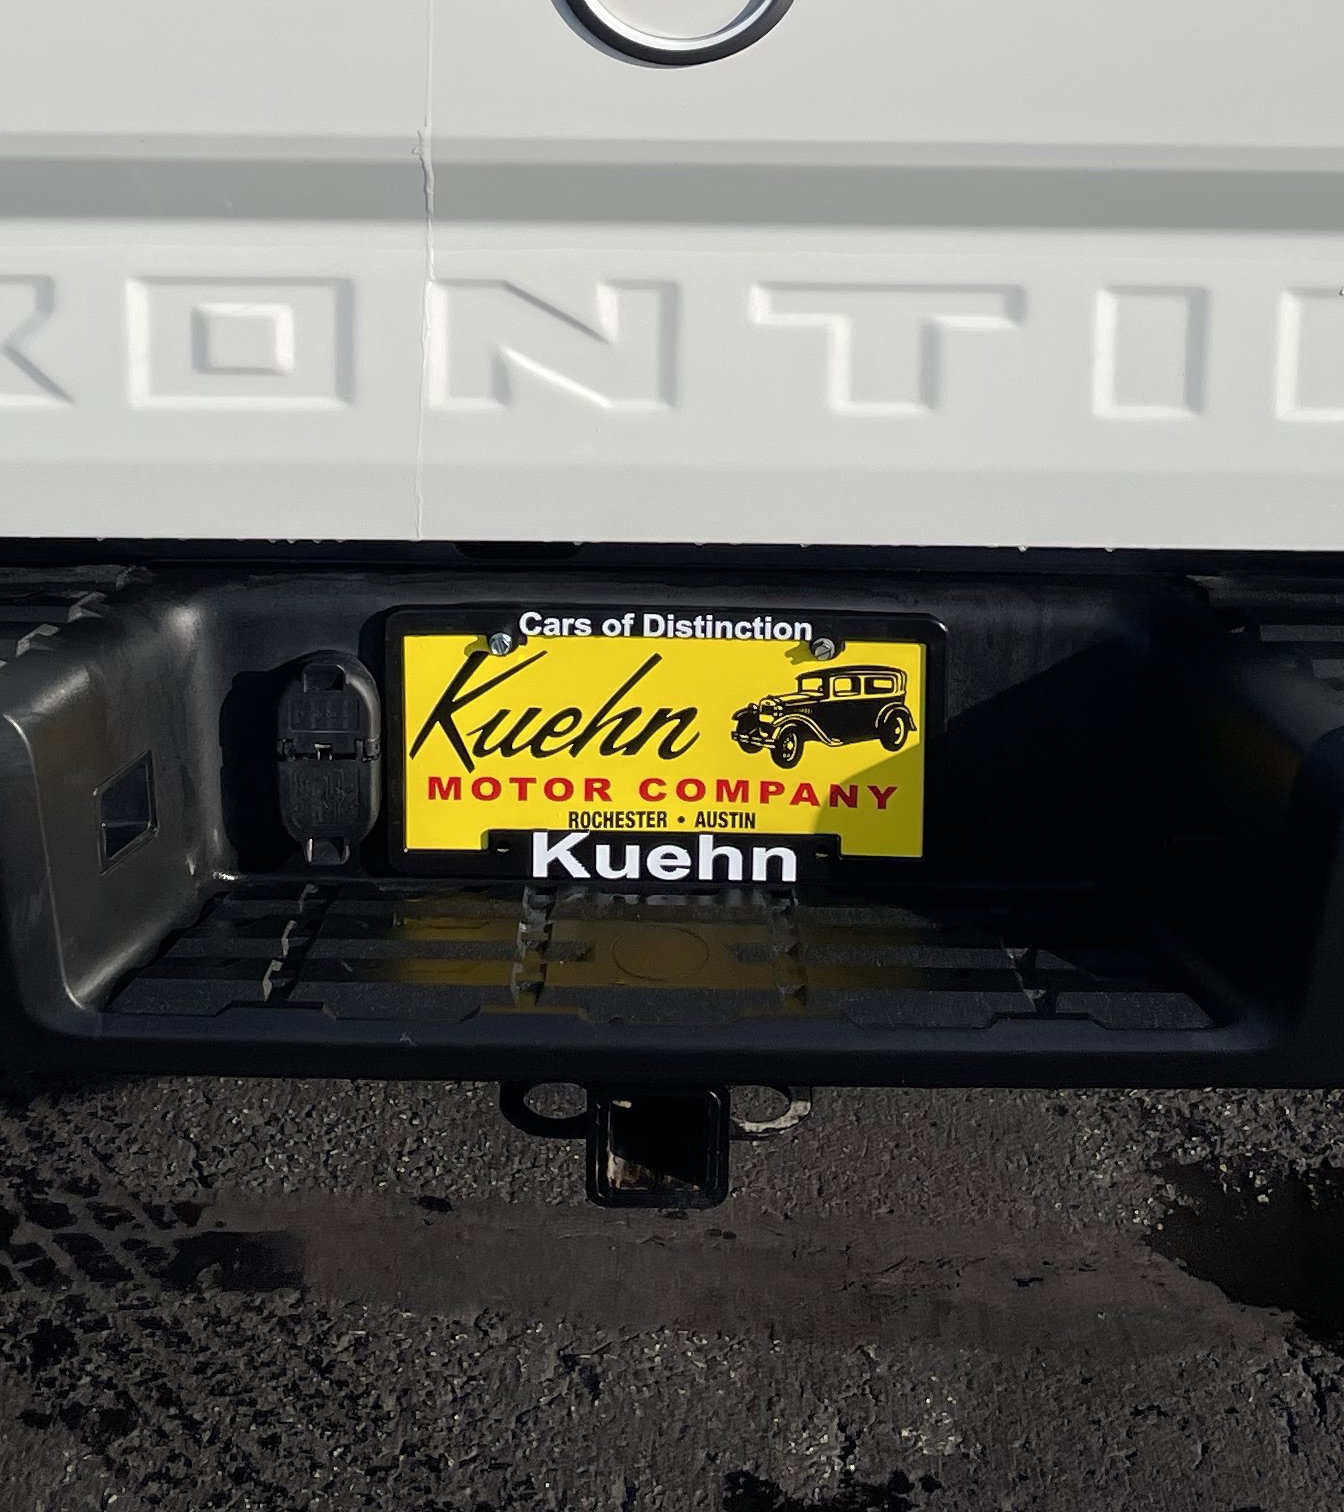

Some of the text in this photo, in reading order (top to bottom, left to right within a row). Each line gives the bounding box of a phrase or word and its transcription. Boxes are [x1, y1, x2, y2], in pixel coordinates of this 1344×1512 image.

[519, 612, 813, 642] Cars of Distinction
[409, 650, 701, 772] Kuehn
[427, 776, 898, 810] MOTOR COMPANY
[568, 810, 757, 830] ROCHESTER AUSTIN
[532, 832, 798, 882] Kuehn
